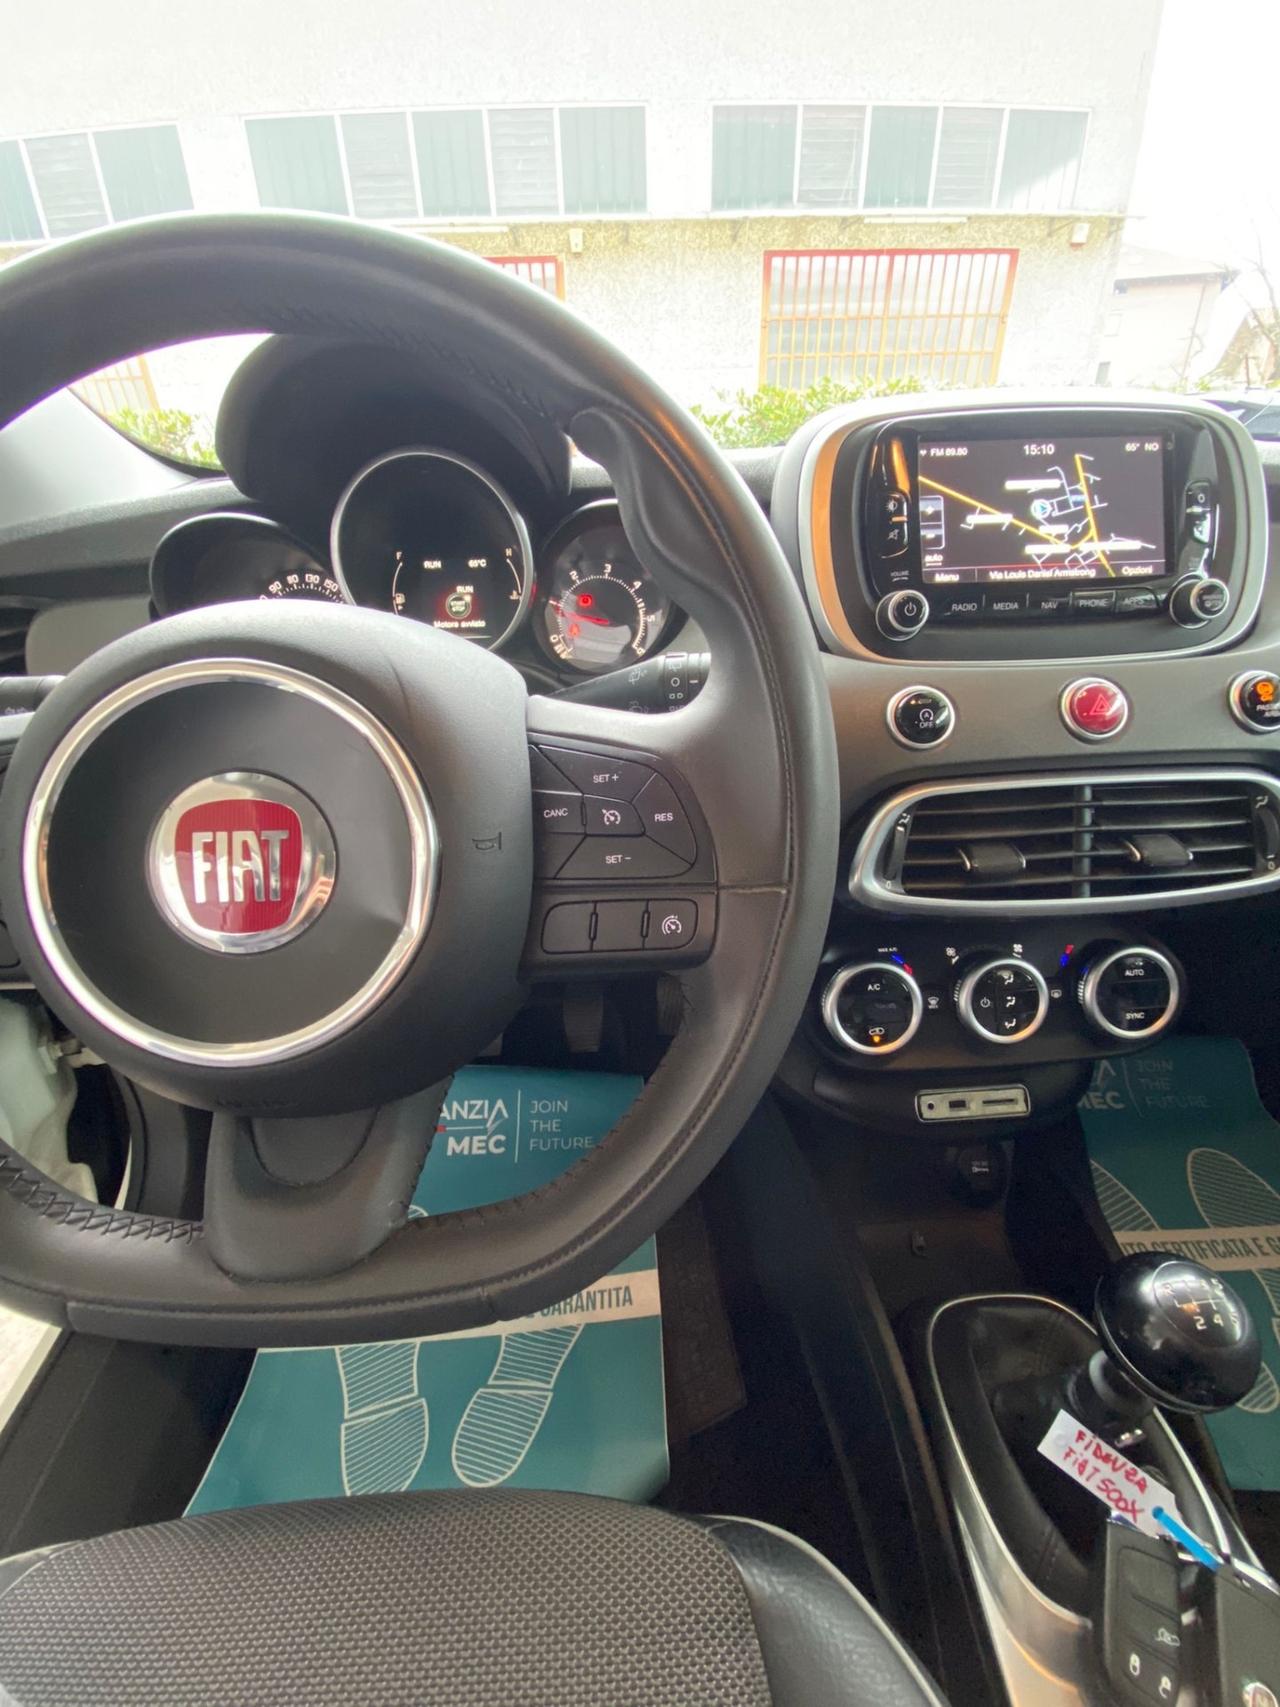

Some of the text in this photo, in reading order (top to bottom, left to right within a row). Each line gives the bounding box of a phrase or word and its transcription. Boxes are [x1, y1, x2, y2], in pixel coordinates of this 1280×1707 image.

[1023, 444, 1055, 455] 15:10
[604, 564, 612, 573] 3
[569, 570, 579, 580] 2
[951, 602, 978, 612] RADIO
[993, 601, 1019, 610] MEDIA
[1041, 601, 1058, 609] NAV
[1079, 598, 1108, 608] PHONE
[543, 808, 569, 818] CANC
[654, 812, 674, 822] RES
[191, 829, 290, 904] FIAT
[1124, 968, 1145, 977] AUTO
[867, 983, 881, 992] A/C
[1125, 1012, 1145, 1020] SYNC
[530, 1100, 568, 1114] JOIN
[530, 1119, 562, 1133] THE
[446, 1134, 595, 1156] MEC FUTURE
[1193, 1315, 1207, 1330] 2
[1096, 1478, 1145, 1523] 500X
